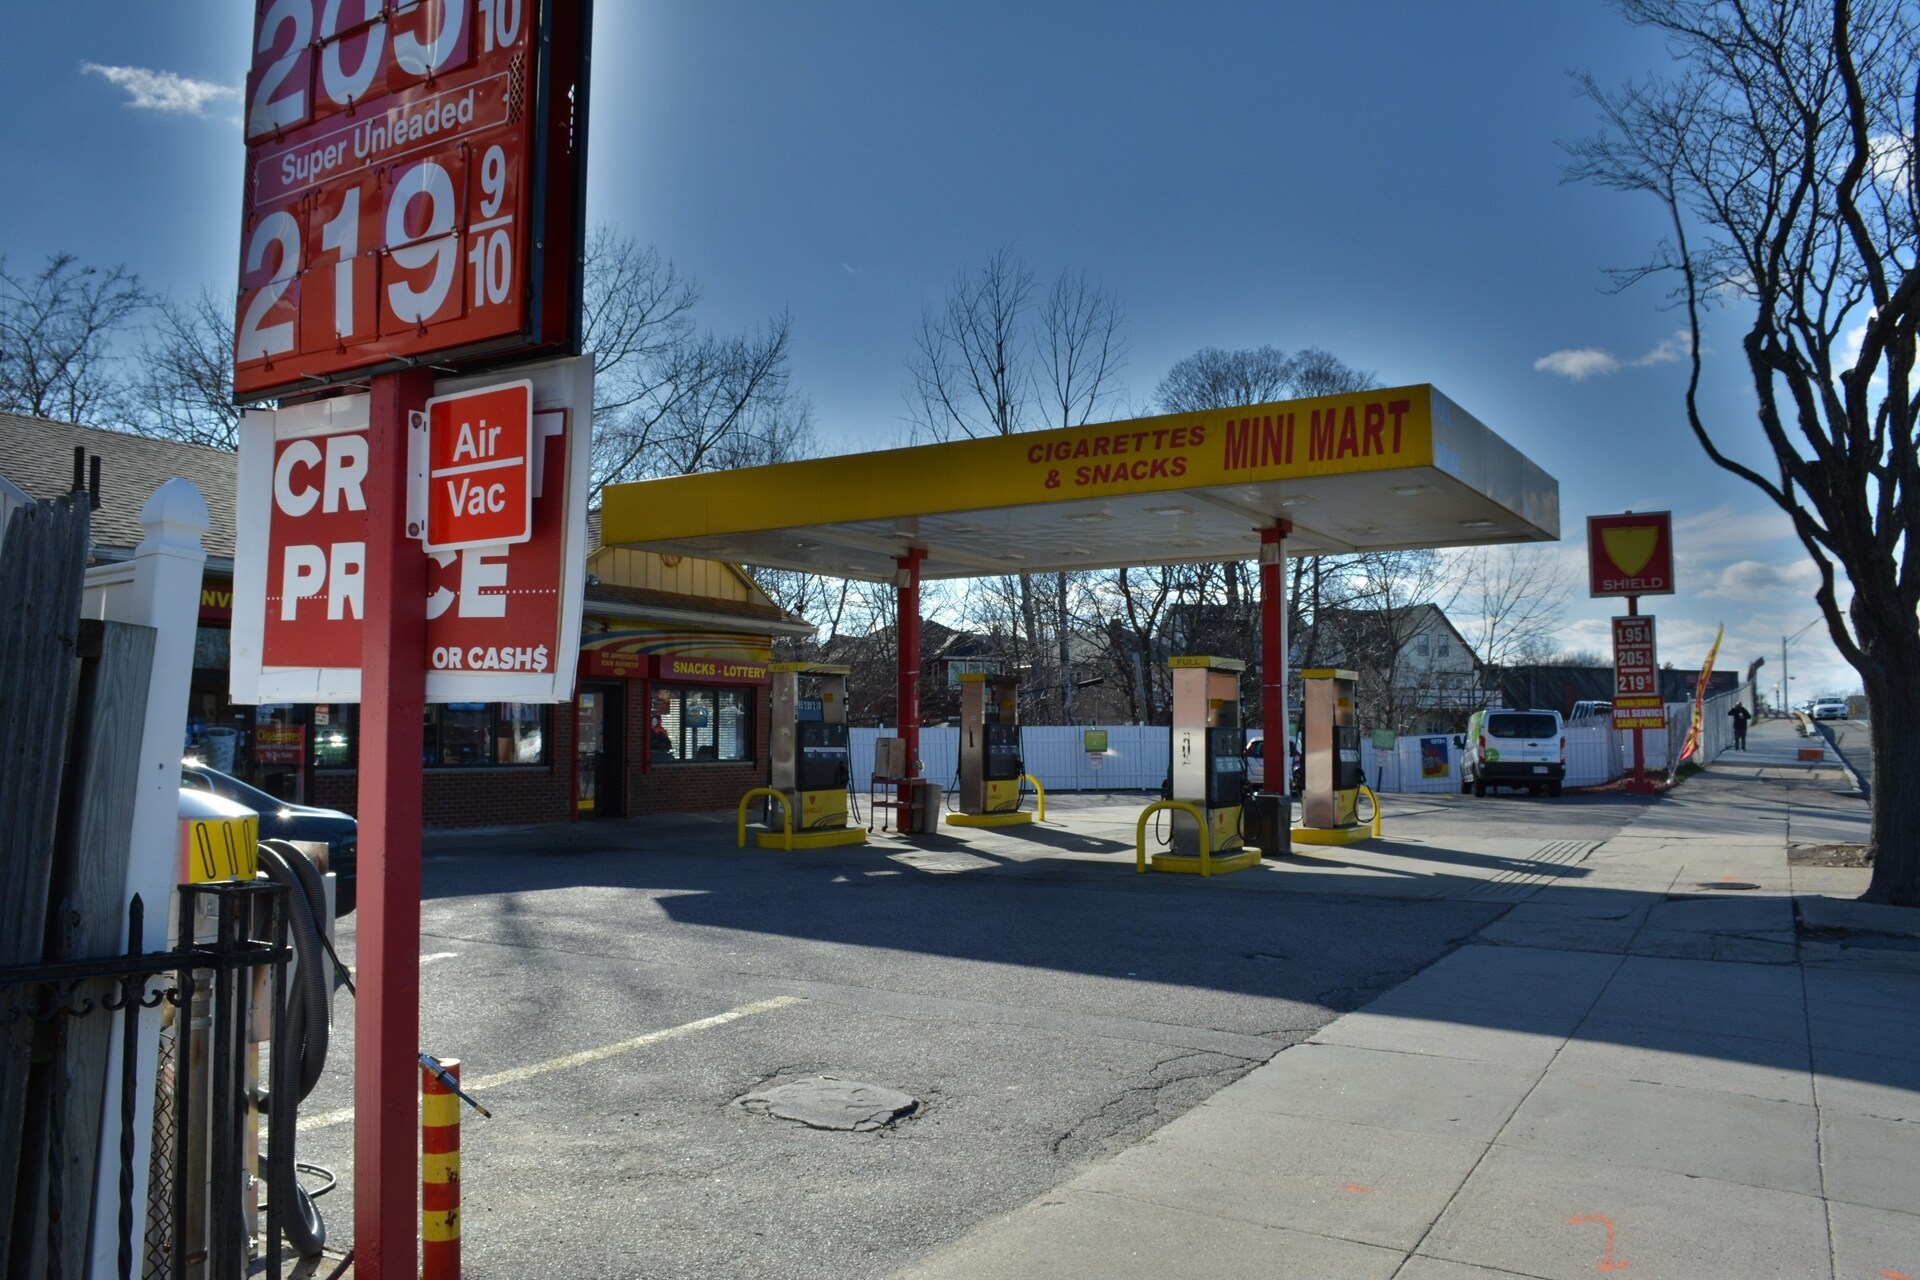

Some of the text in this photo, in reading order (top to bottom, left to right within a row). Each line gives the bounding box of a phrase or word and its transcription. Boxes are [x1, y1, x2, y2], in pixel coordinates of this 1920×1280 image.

[281, 89, 474, 185] Super Unleaded
[480, 144, 506, 219] 9
[237, 162, 457, 364] 219
[468, 229, 512, 308] 10
[452, 419, 502, 462] Air
[1027, 425, 1206, 464] CIGARETTES
[1223, 400, 1410, 471] MINI MART
[1044, 456, 1188, 489] & SNACKS
[447, 478, 506, 517] Vac
[281, 541, 509, 621] PRCE
[1603, 578, 1663, 590] SHIELD
[467, 644, 548, 672] CASH$
[673, 661, 715, 676] SNACKS
[723, 665, 767, 679] LOTTERY
[1176, 658, 1201, 666] FULL
[1619, 675, 1645, 691] 219
[1614, 708, 1663, 718] FULL SERVICE
